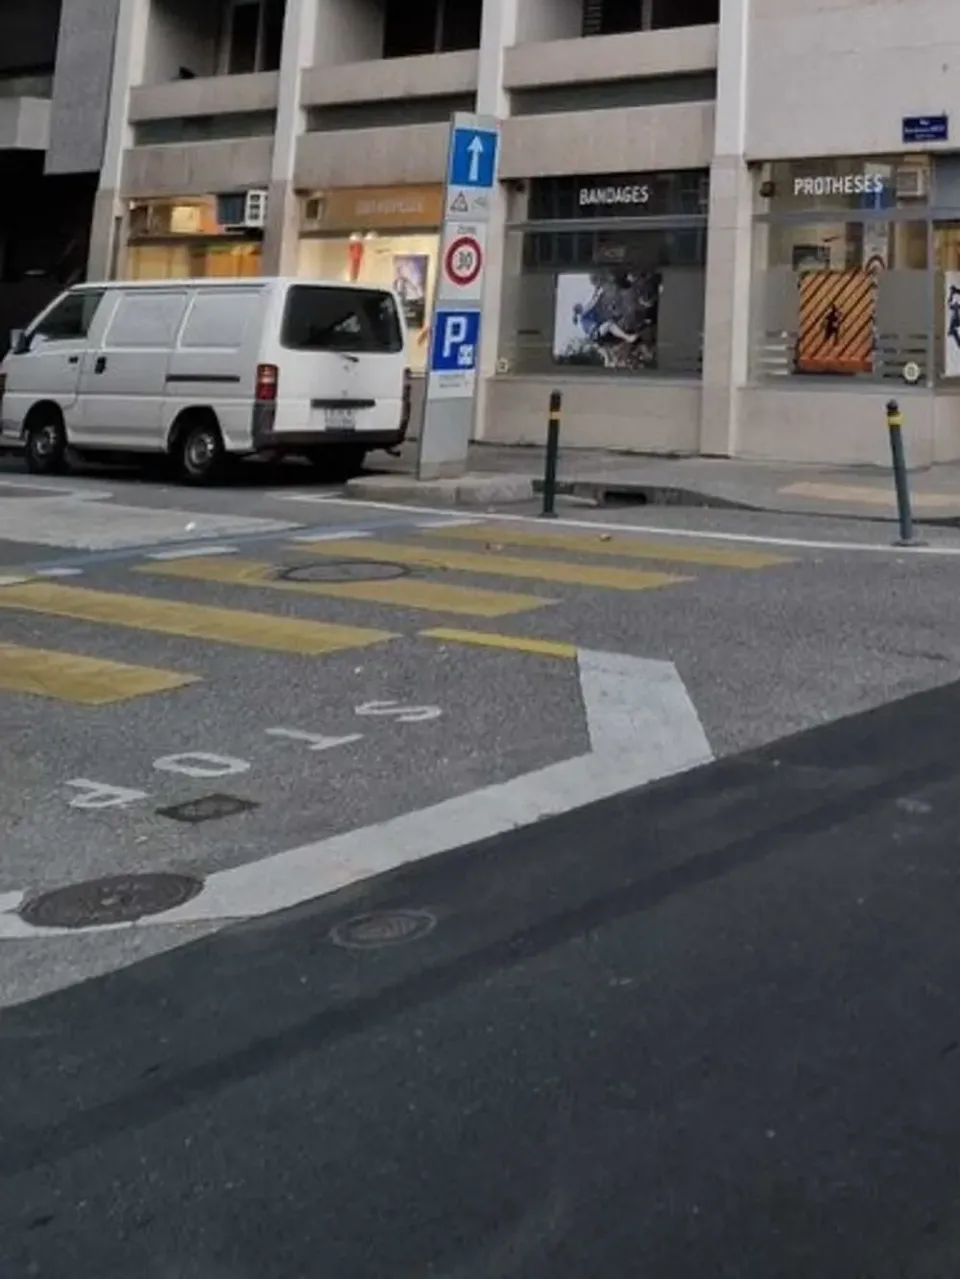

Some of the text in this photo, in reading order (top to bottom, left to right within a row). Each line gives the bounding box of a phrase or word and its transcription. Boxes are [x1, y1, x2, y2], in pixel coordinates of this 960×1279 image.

[579, 185, 650, 206] BANDAGES
[794, 174, 884, 196] PROTHESES
[456, 250, 474, 271] 30
[442, 316, 467, 357] P
[65, 700, 443, 809] STOP
